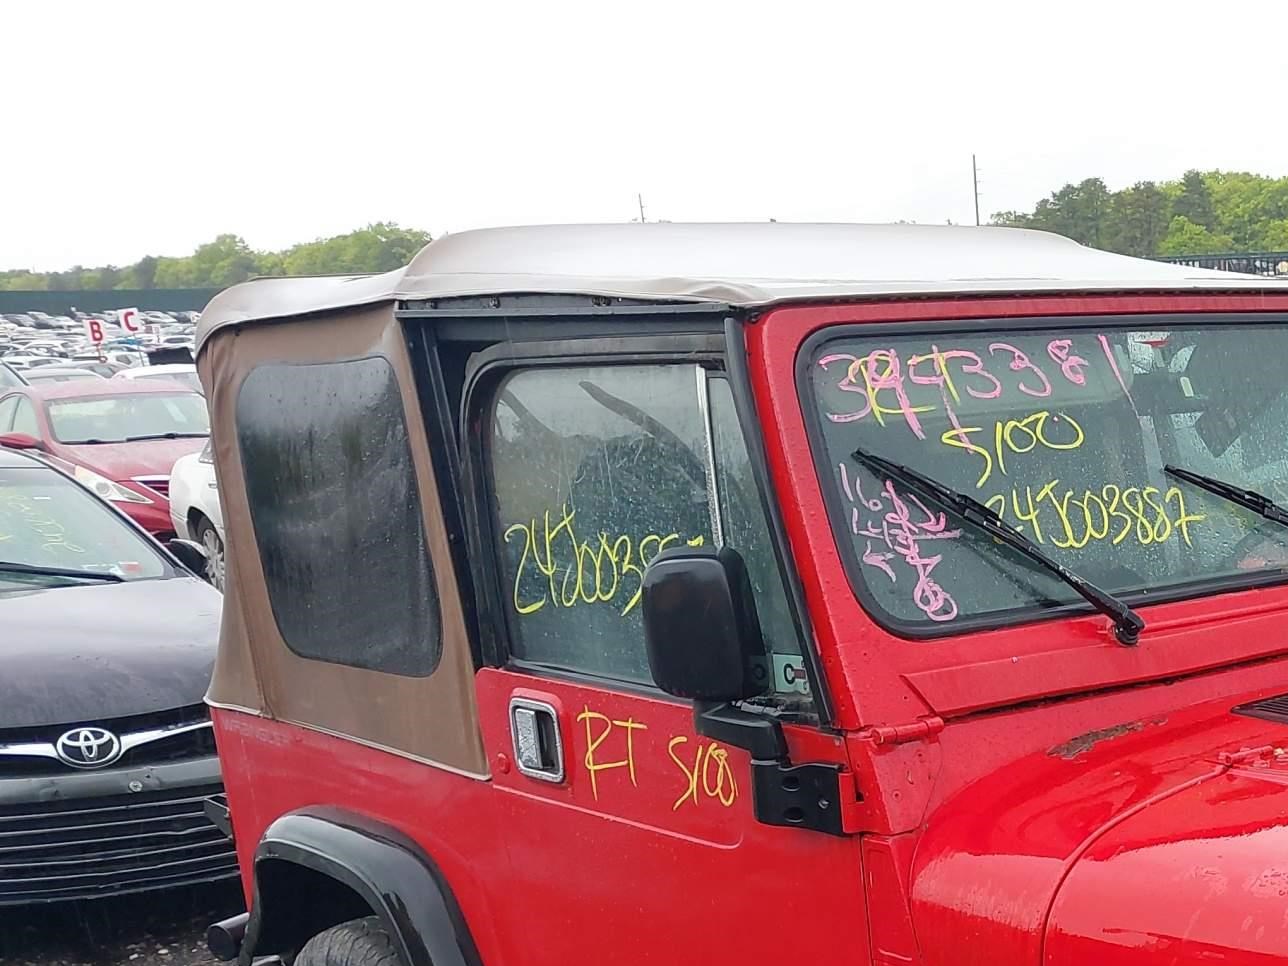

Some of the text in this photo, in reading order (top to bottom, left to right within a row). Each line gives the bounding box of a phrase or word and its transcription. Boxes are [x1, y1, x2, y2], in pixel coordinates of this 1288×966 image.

[88, 320, 104, 342] B
[123, 311, 139, 332] C
[576, 704, 648, 800] RT
